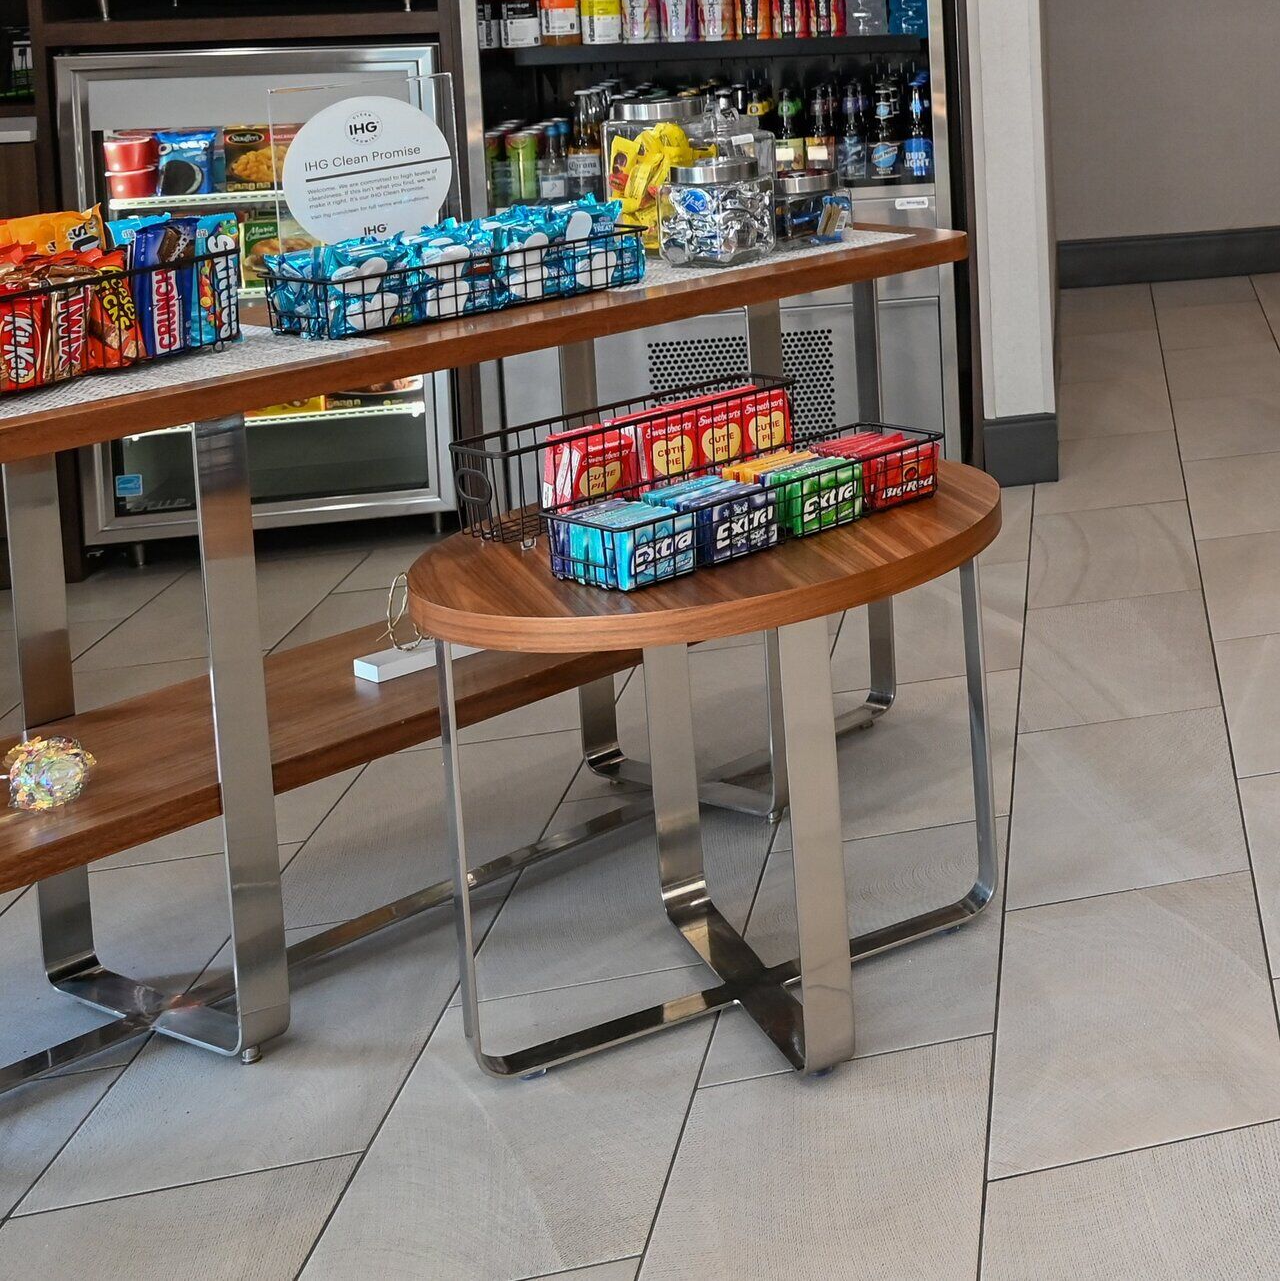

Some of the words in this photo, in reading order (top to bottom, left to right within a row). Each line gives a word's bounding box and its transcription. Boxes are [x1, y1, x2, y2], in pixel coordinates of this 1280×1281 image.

[349, 121, 379, 135] IHG
[304, 159, 329, 172] IHG
[332, 154, 369, 168] Clean
[372, 145, 421, 164] Promise
[906, 152, 926, 160] BUD
[904, 159, 930, 167] LIGHT
[363, 224, 387, 236] IHG
[207, 234, 238, 339] Skittles
[154, 268, 179, 350] CRUNCH
[59, 284, 91, 371] TWIX
[698, 410, 741, 427] Sweethearts
[646, 422, 692, 439] Sweethearts
[755, 419, 780, 432] CUTIE
[708, 432, 735, 444] CUTIE
[762, 432, 776, 442] PIE
[657, 445, 686, 457] CUTIE
[715, 445, 729, 454] PIE
[666, 458, 681, 466] PIE
[588, 469, 616, 482] CUTIE
[591, 481, 606, 490] PIE
[803, 481, 858, 523] Extra
[716, 505, 774, 550] Extra
[631, 530, 693, 577] Extra
